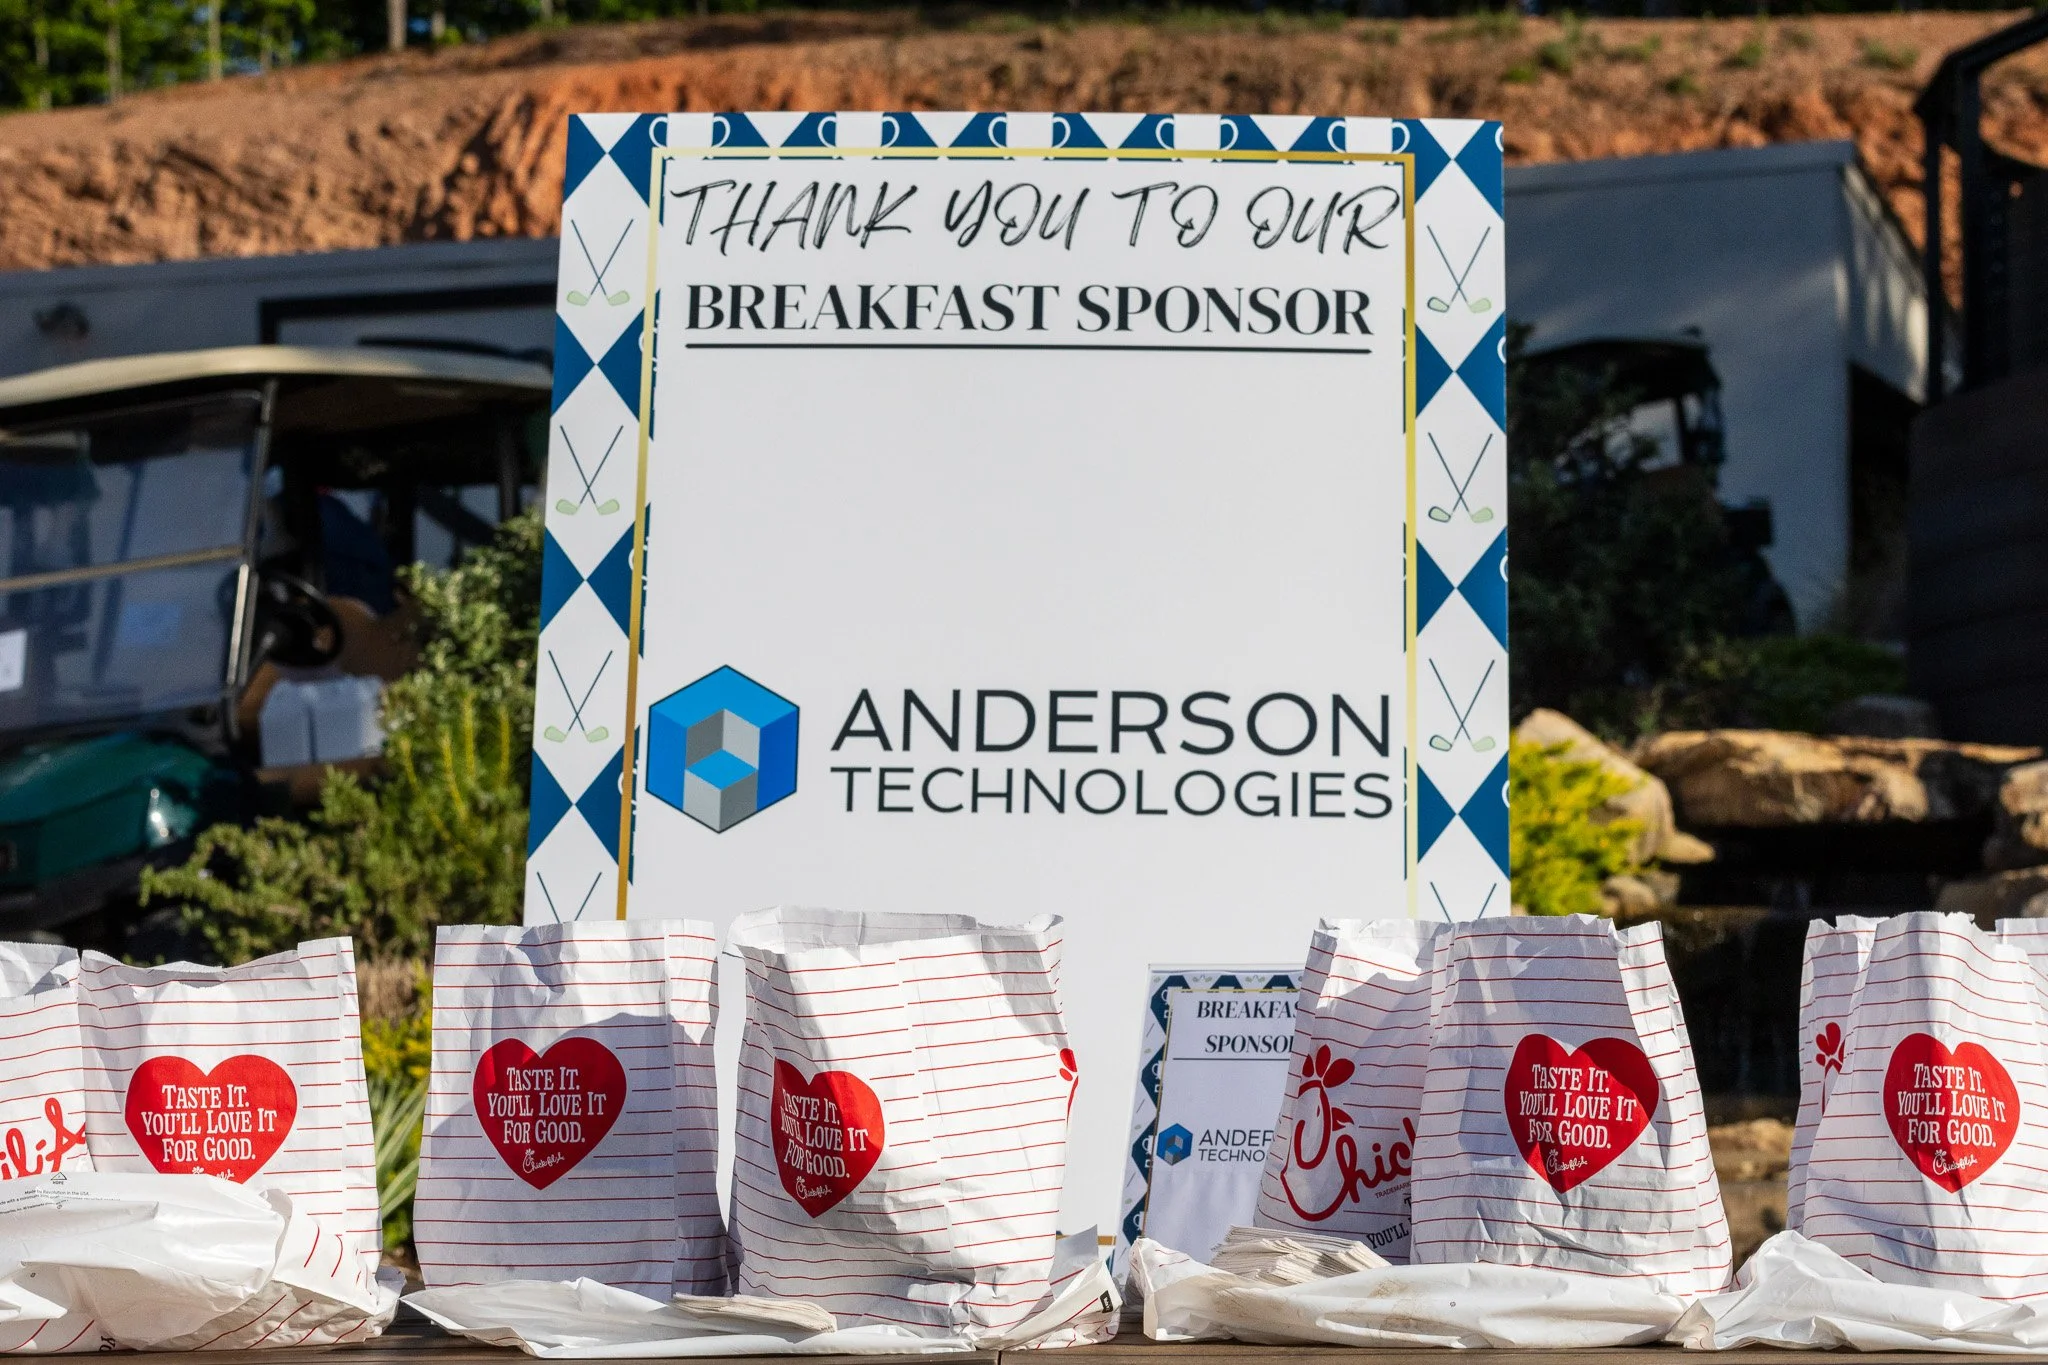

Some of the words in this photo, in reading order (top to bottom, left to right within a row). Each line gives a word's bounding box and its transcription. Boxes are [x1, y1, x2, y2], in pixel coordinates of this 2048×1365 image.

[671, 180, 917, 255] THANK
[945, 181, 1089, 249] YOU
[1112, 182, 1217, 248] TO
[1247, 186, 1400, 254] OUR
[685, 284, 1060, 332] BREAKFAST
[1077, 285, 1374, 335] SPONSOR
[830, 688, 1390, 758] ANDERSON
[830, 766, 1393, 819] TECHNOLOGIES
[506, 1067, 554, 1091] TASTE
[559, 1067, 580, 1091] IT.
[1532, 1063, 1582, 1091] TASTE
[1587, 1067, 1609, 1093] IT.
[1914, 1063, 1965, 1090] TASTE
[1968, 1066, 1985, 1094] IT.
[162, 1084, 221, 1109] TASTE
[227, 1084, 250, 1107] IT.
[487, 1093, 533, 1117] YOU'LL
[539, 1092, 582, 1116] LOVE
[587, 1092, 606, 1115] IT
[1520, 1091, 1558, 1116] YOU'LL
[1563, 1092, 1611, 1120] LOVE
[1615, 1096, 1637, 1122] IT
[1897, 1091, 1945, 1116] YOU'LL
[1950, 1090, 1991, 1119] LOVE
[1991, 1096, 2006, 1123] IT
[141, 1111, 201, 1136] YOU'LL
[206, 1110, 252, 1134] LOVE
[257, 1108, 277, 1132] IT
[503, 1120, 530, 1144] FOR
[535, 1119, 586, 1144] GOOD.
[805, 1122, 843, 1151] LOVE
[847, 1127, 868, 1152] IT
[1527, 1118, 1554, 1143] FOR
[1558, 1120, 1611, 1149] GOOD.
[1907, 1118, 1941, 1144] FOR
[1947, 1119, 1996, 1148] GOOD.
[162, 1138, 198, 1162] FOR
[203, 1137, 256, 1161] GOOD.
[1198, 1149, 1266, 1162] TECHNO
[1366, 1222, 1409, 1249] YOU'LL
